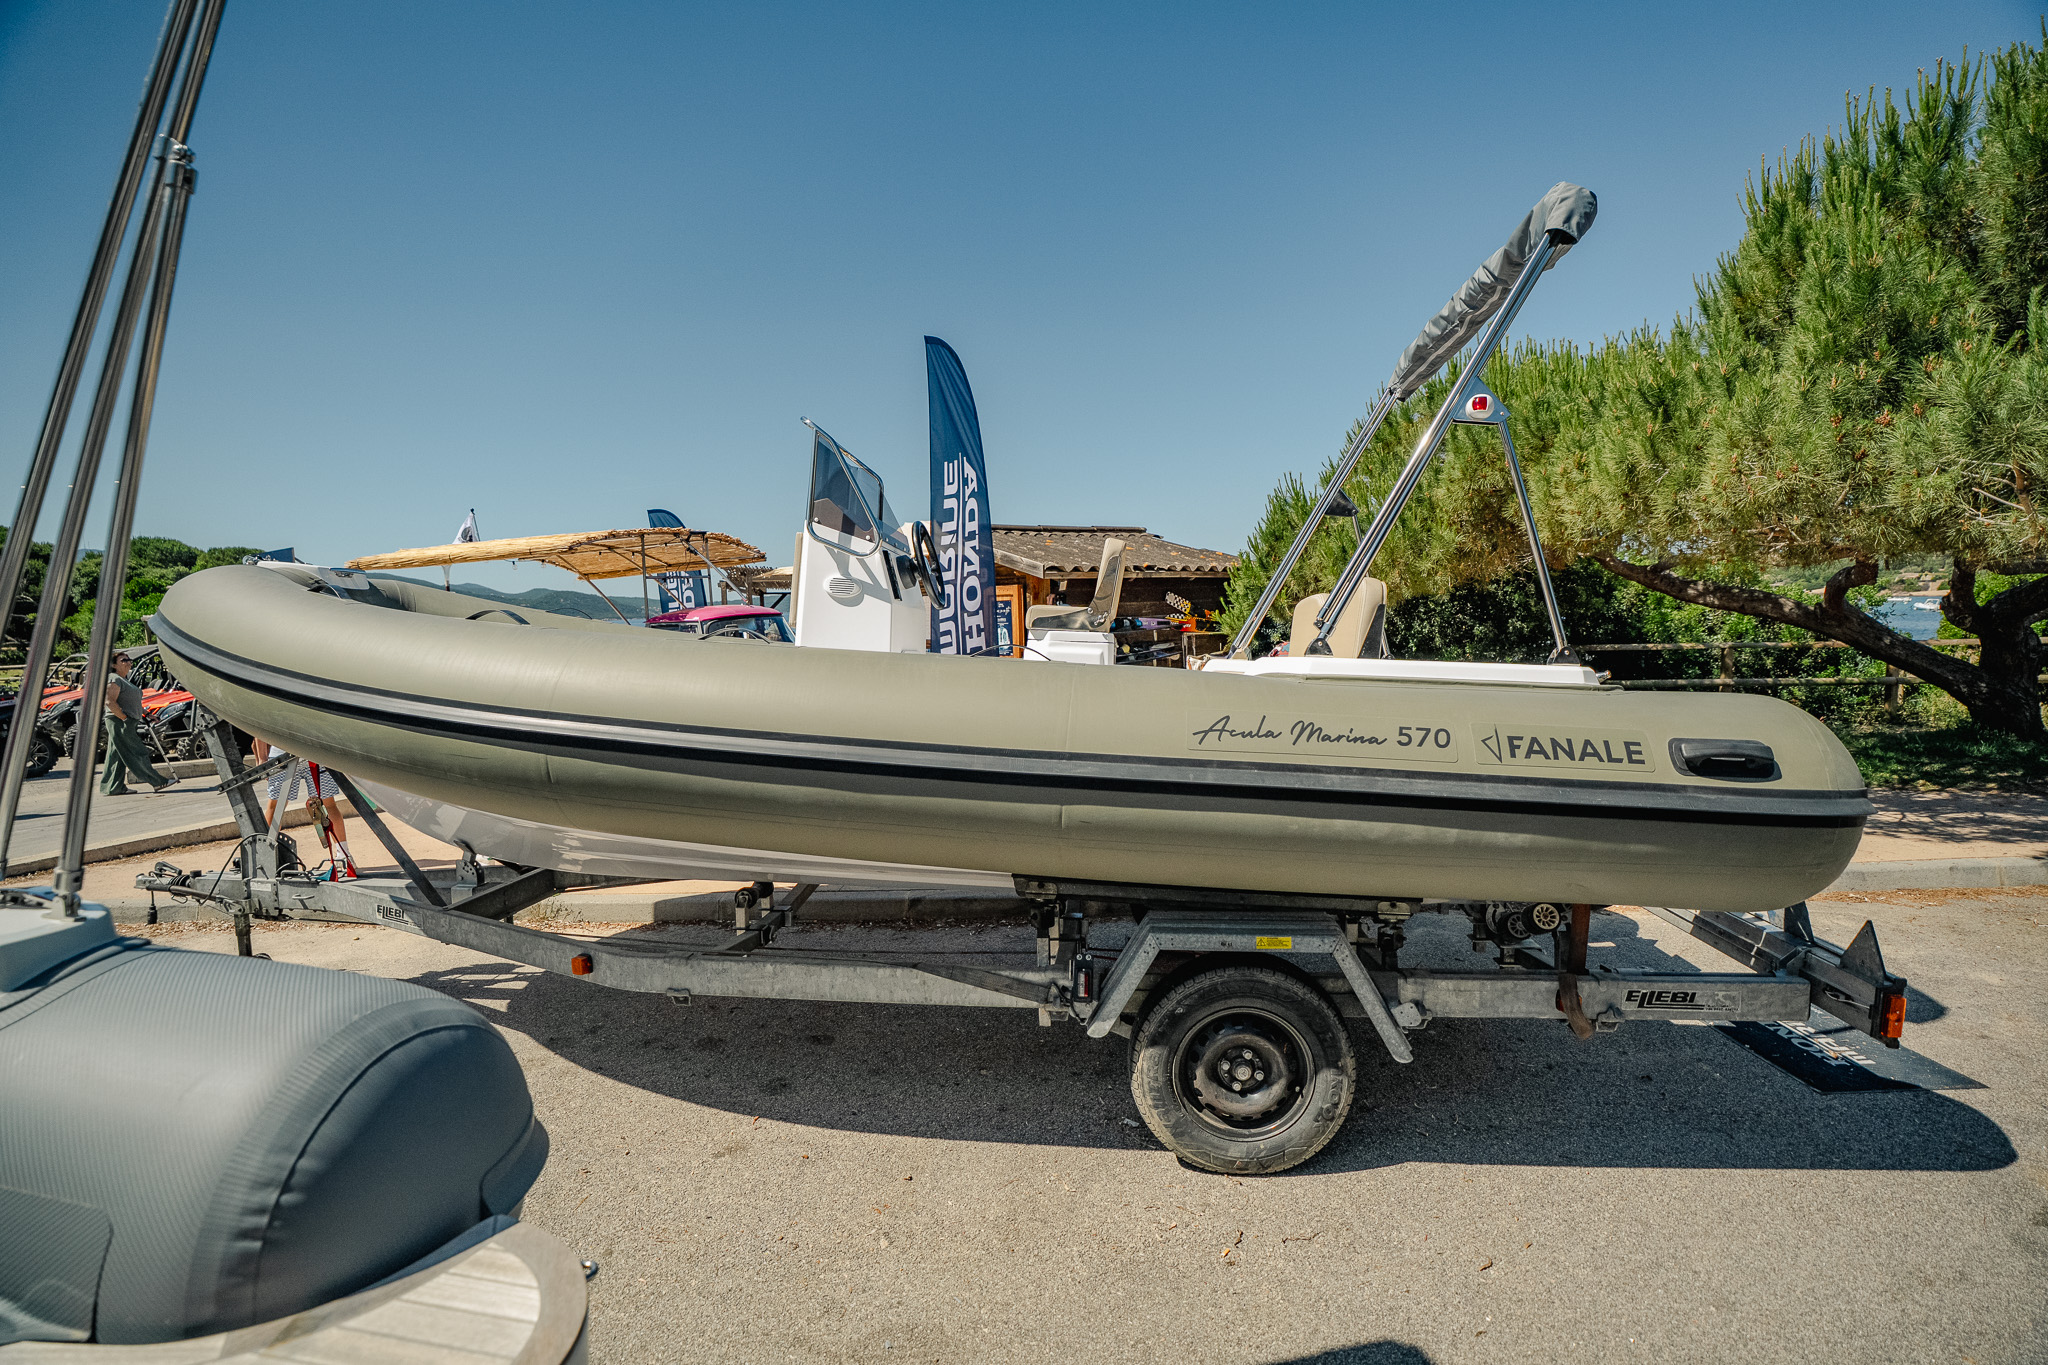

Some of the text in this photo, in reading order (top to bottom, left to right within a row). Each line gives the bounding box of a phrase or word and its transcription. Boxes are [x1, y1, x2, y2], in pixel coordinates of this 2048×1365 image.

[1192, 714, 1451, 749] Acula Marina 570
[1507, 735, 1646, 765] FANALE
[377, 904, 405, 919] ELLEBI
[1625, 990, 1697, 1009] ELLEBI
